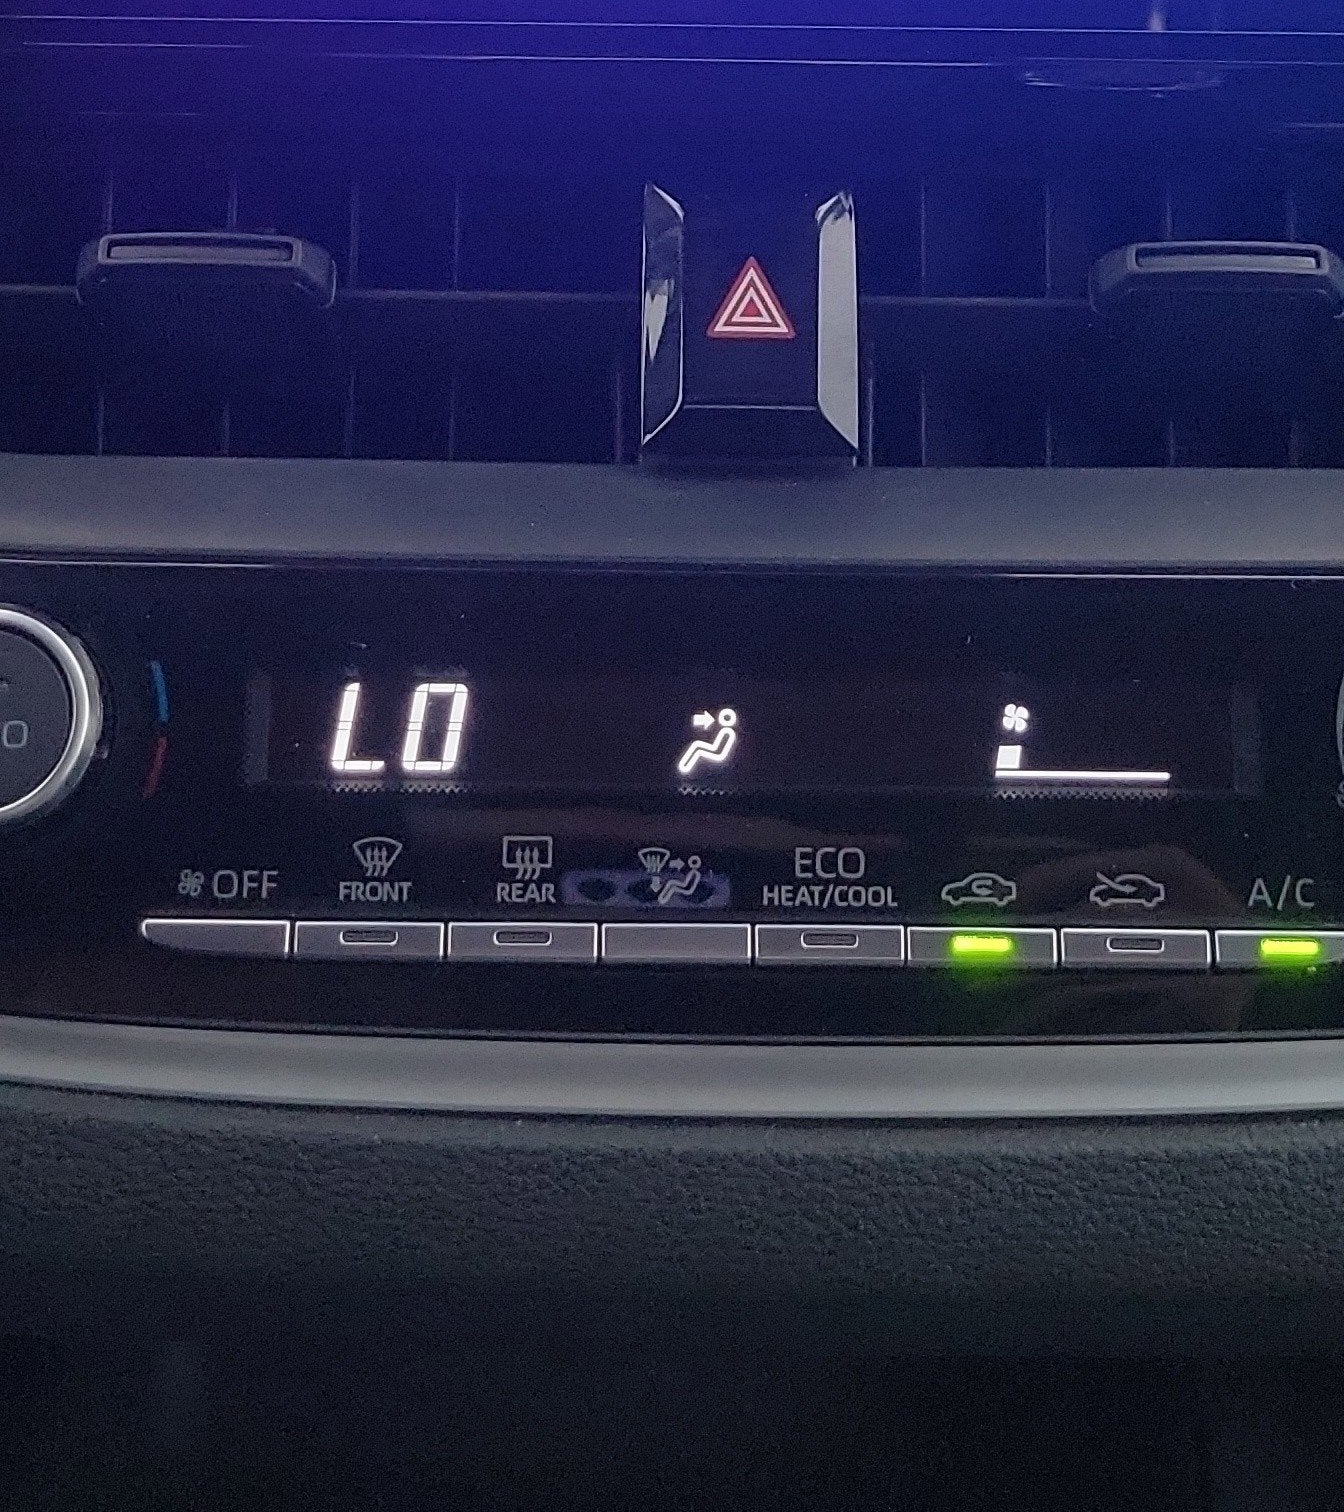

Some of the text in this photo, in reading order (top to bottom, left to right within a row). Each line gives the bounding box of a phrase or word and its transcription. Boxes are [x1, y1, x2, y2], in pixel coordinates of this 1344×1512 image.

[331, 683, 469, 773] LO
[794, 846, 866, 880] ECO
[212, 869, 279, 900] OFF
[338, 881, 412, 902] FRONT
[496, 881, 556, 904] REAR
[762, 884, 898, 908] HEAT/COOL
[1247, 875, 1316, 911] A/C
